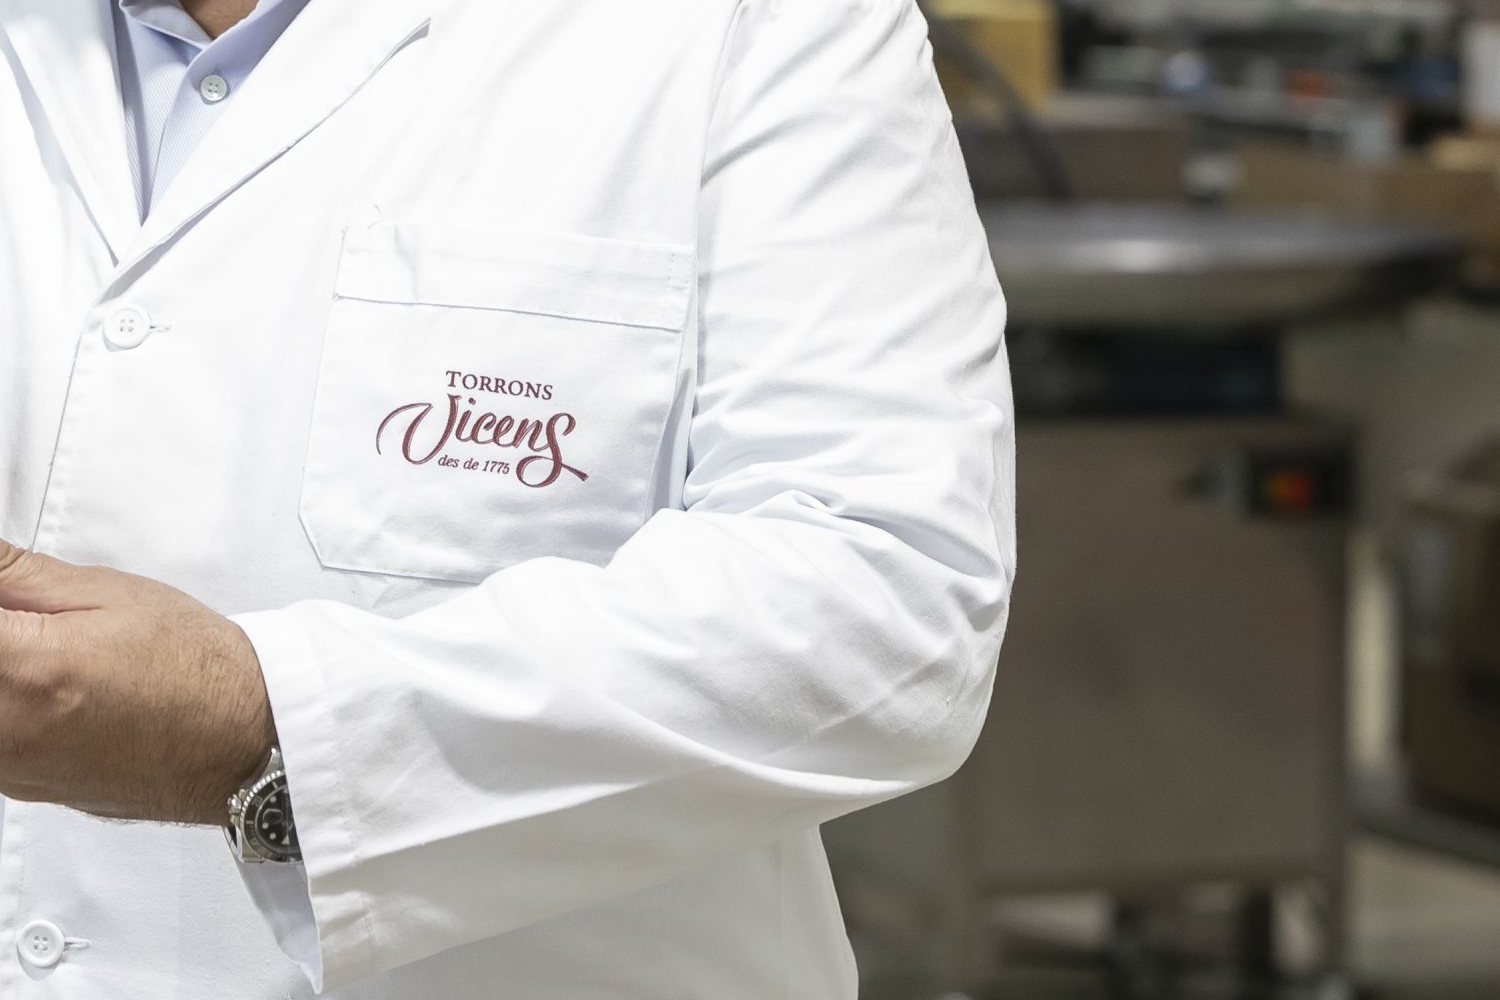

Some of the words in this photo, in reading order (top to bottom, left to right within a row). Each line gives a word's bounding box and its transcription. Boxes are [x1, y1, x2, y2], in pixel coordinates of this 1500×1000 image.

[445, 370, 553, 400] TORRONS
[376, 393, 589, 488] Vicens
[438, 454, 459, 469] des
[463, 458, 479, 471] de
[482, 460, 511, 475] 1775
